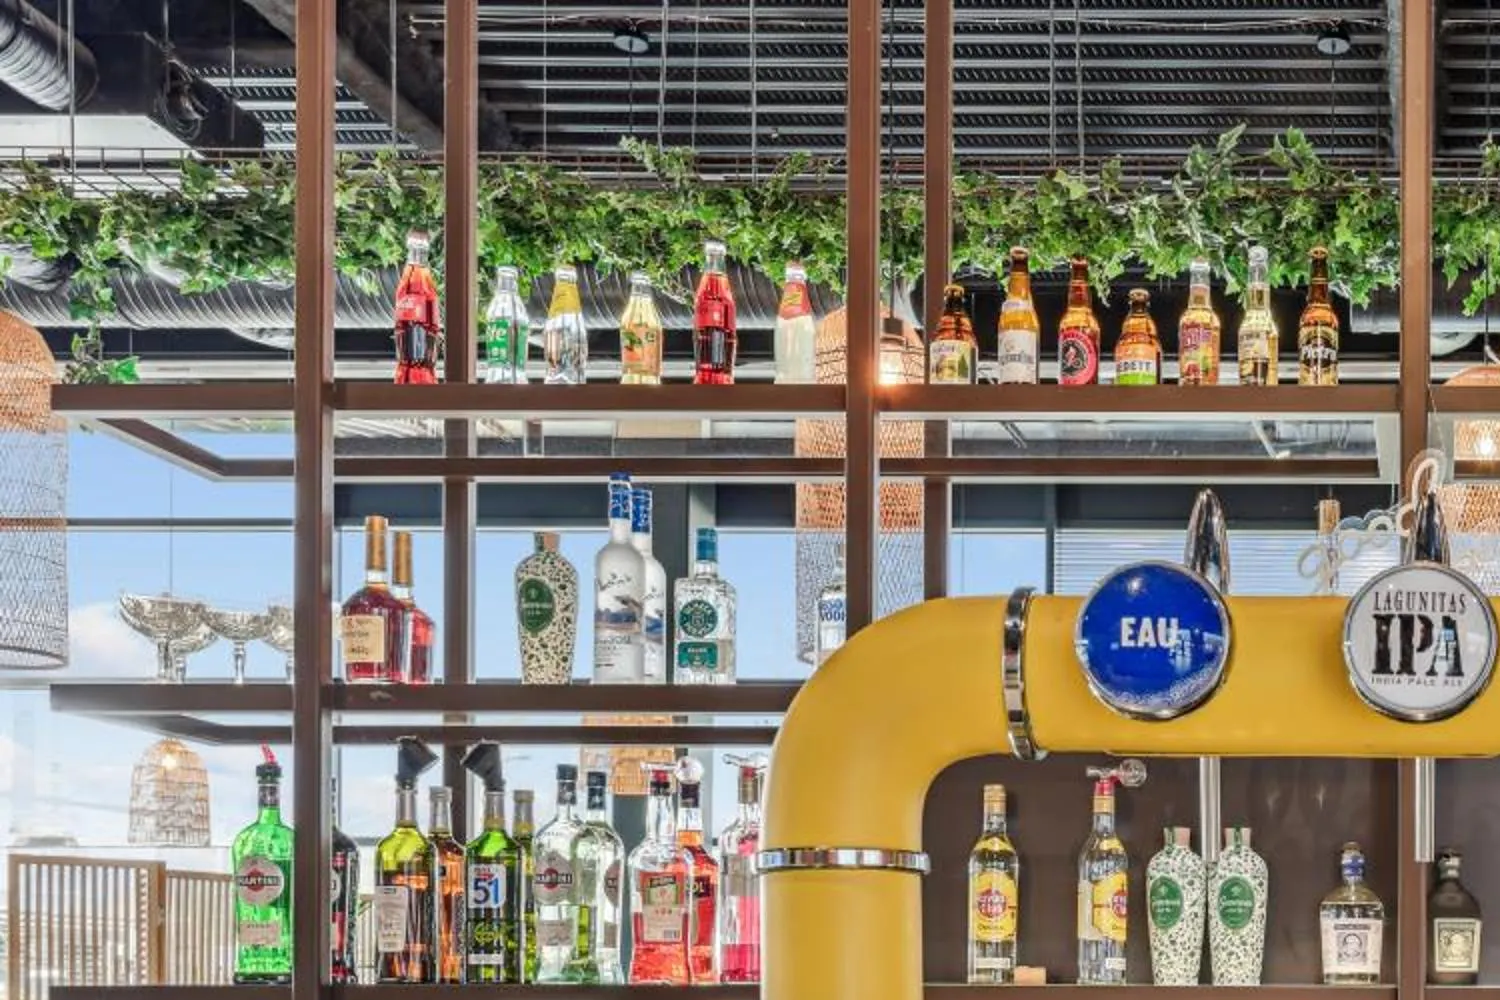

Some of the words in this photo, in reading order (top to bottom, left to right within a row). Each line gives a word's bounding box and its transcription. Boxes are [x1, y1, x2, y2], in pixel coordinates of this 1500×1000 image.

[1374, 591, 1467, 614] LAGUNITAS
[1121, 617, 1179, 648] EAU
[1372, 613, 1464, 677] IPA
[473, 878, 500, 905] 51
